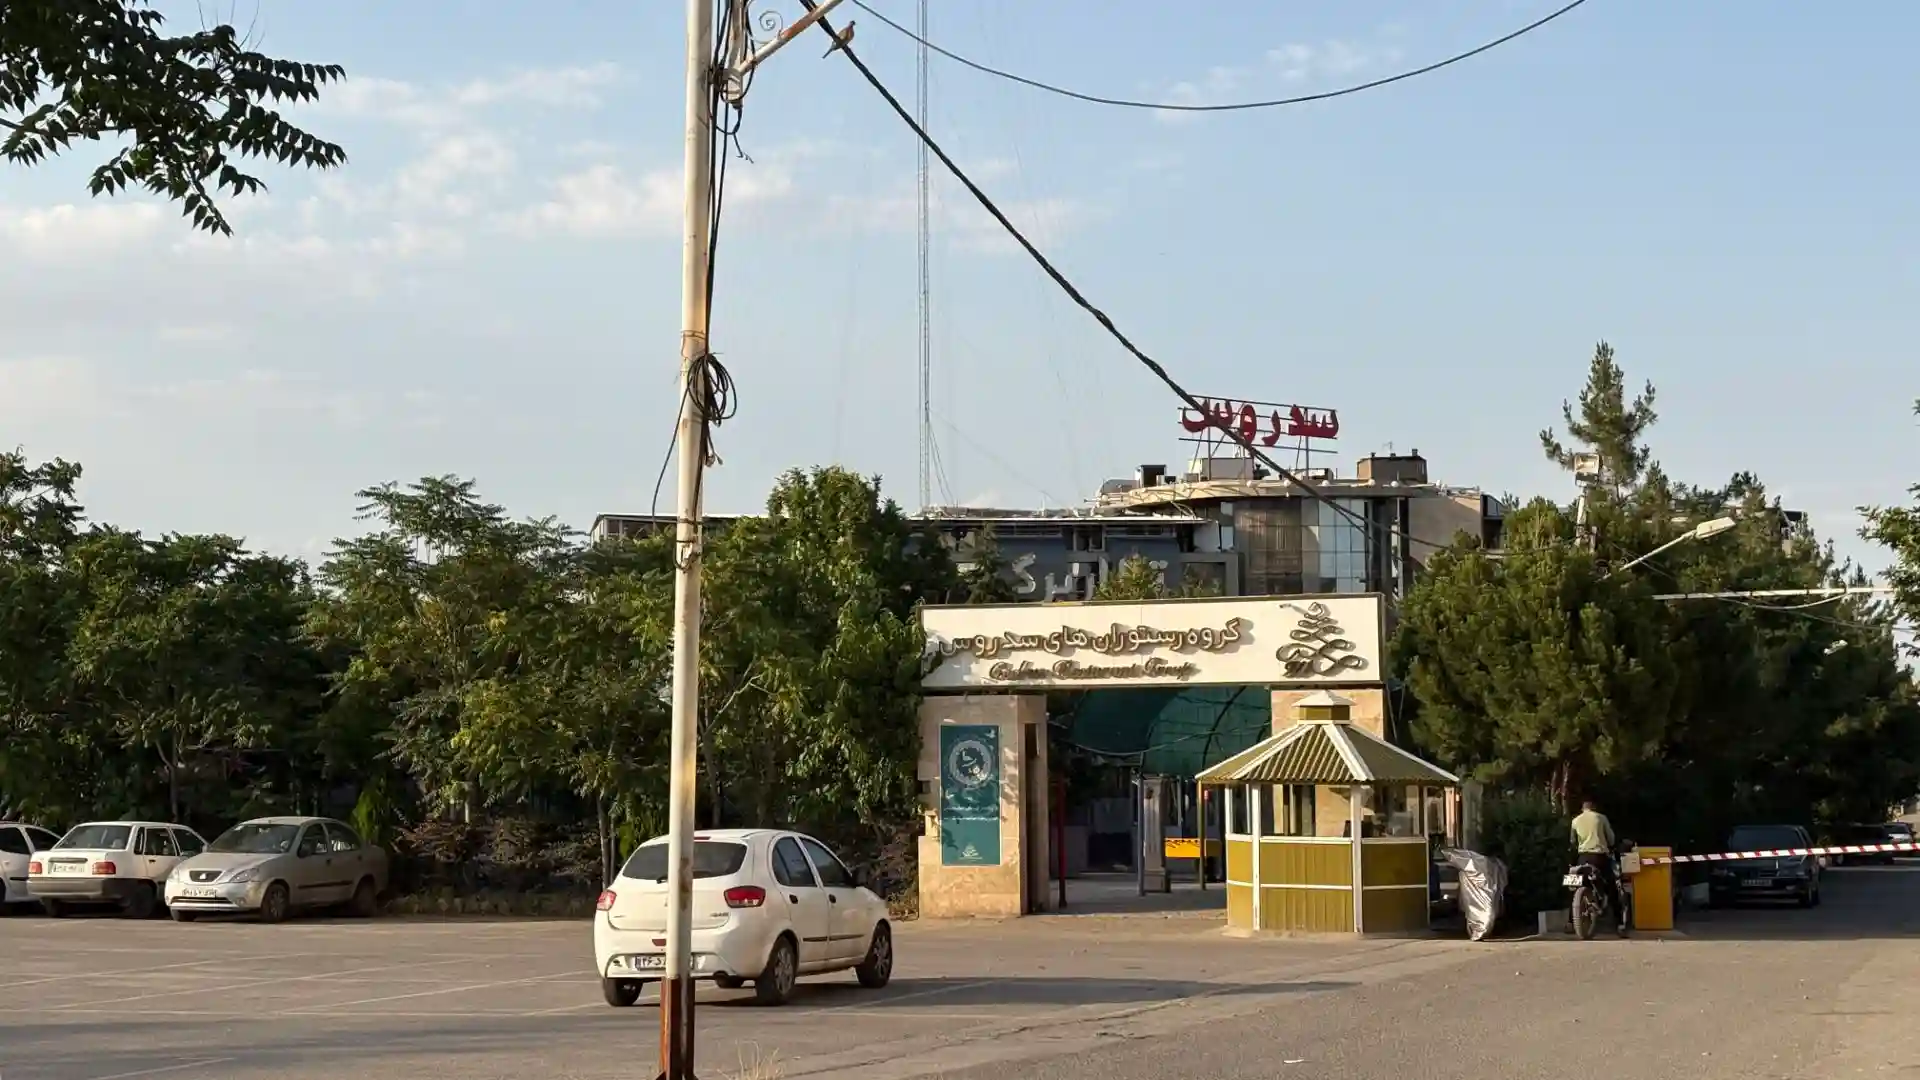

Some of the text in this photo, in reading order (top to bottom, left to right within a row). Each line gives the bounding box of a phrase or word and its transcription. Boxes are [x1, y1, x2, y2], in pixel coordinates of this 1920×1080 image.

[1182, 397, 1339, 446] سدروس
[939, 631, 1038, 657] سدروس
[1187, 617, 1240, 650] گروه
